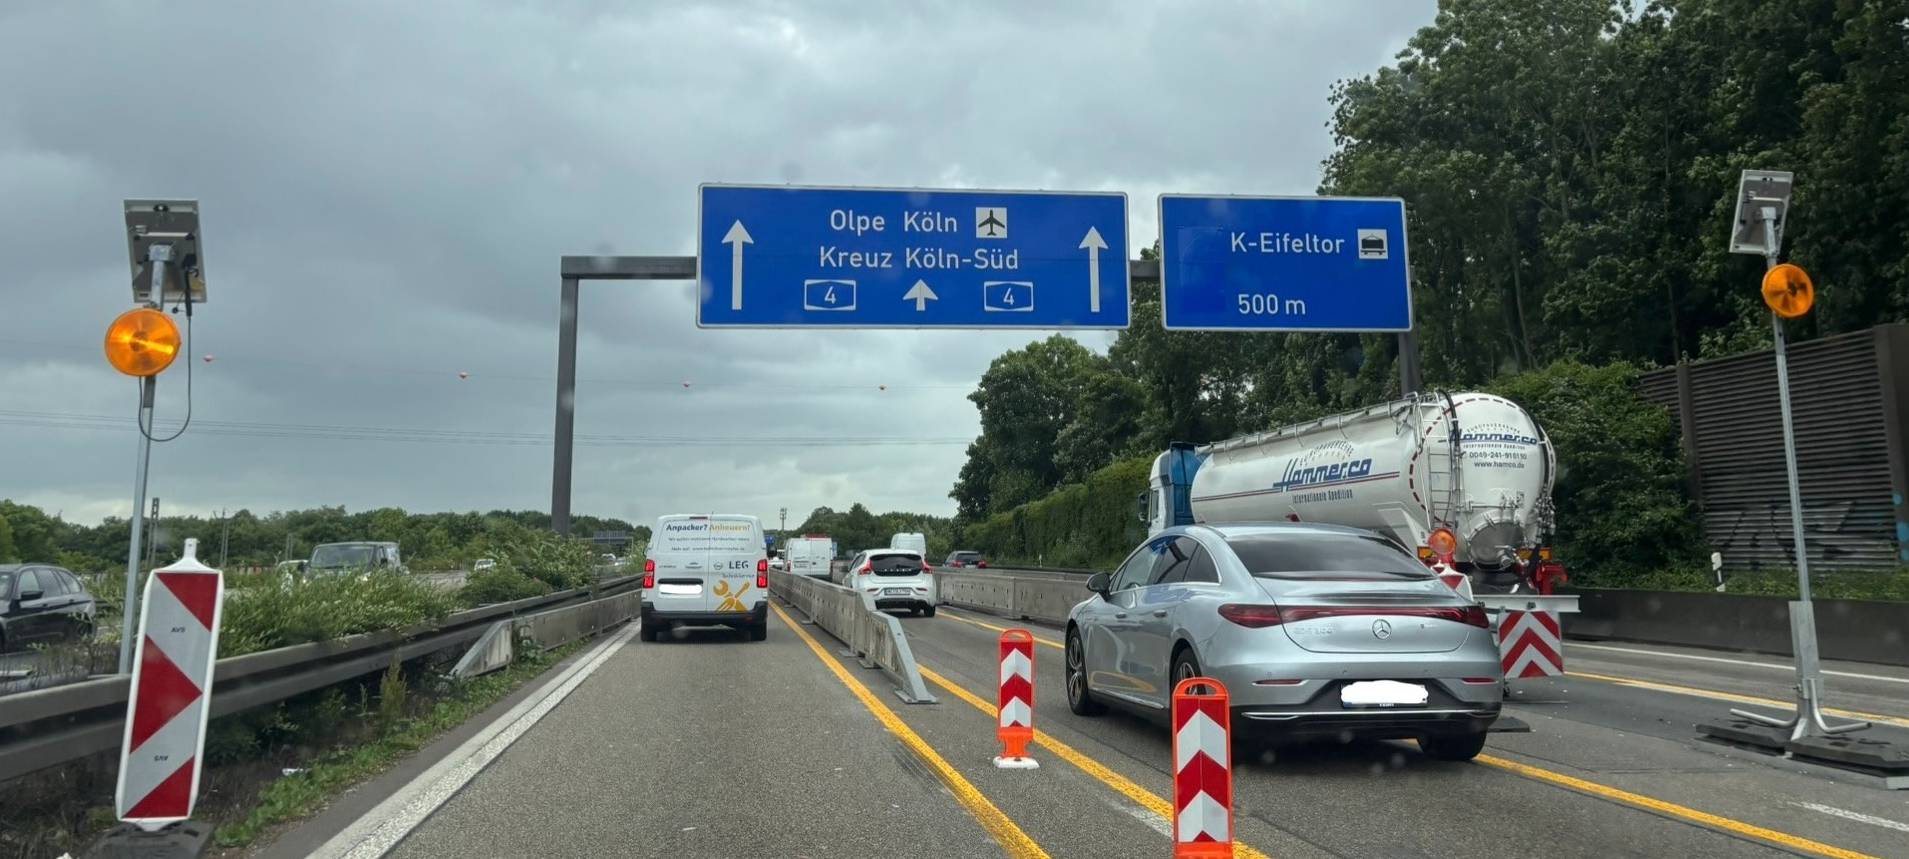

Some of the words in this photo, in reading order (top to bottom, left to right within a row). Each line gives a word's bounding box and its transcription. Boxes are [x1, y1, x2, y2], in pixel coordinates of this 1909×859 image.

[830, 209, 885, 236] Olpe
[903, 211, 958, 233] Köln
[1230, 231, 1345, 254] K-Eifeltor
[819, 246, 893, 269] Kreuz
[905, 247, 1019, 270] Köln-Süd
[823, 286, 837, 305] 4
[1003, 287, 1016, 306] 4
[1238, 293, 1279, 315] 500
[1285, 299, 1306, 315] m
[666, 524, 708, 532] Anpacker?
[728, 560, 749, 570] LEG
